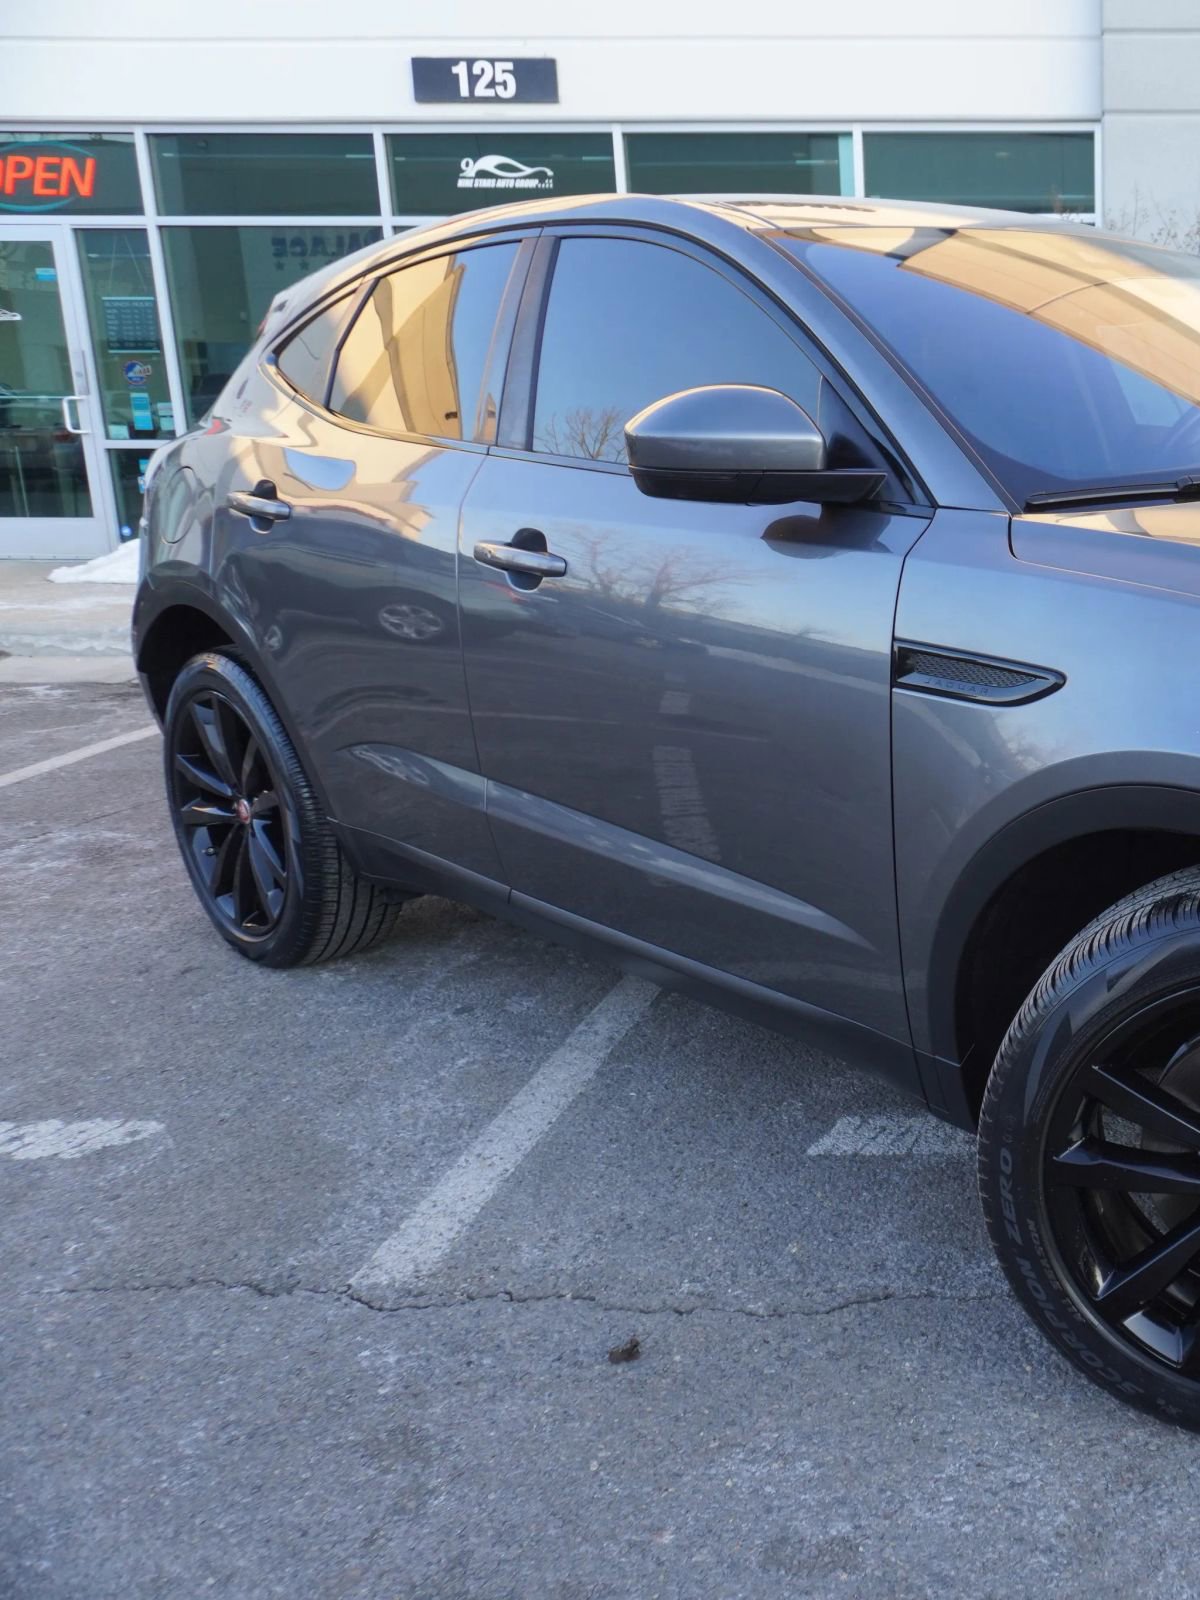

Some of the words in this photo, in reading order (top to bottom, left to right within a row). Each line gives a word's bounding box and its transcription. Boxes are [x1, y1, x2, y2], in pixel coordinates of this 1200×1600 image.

[451, 60, 517, 99] 125
[0, 155, 97, 197] PEN
[456, 178, 474, 189] NINE
[474, 178, 497, 189] STARS
[496, 178, 515, 189] AUTO
[515, 178, 539, 189] GROUP
[459, 157, 475, 177] 9
[924, 678, 989, 696] JAGUAR
[999, 1147, 1025, 1246] ZERO
[1016, 1256, 1145, 1395] SCORPION
